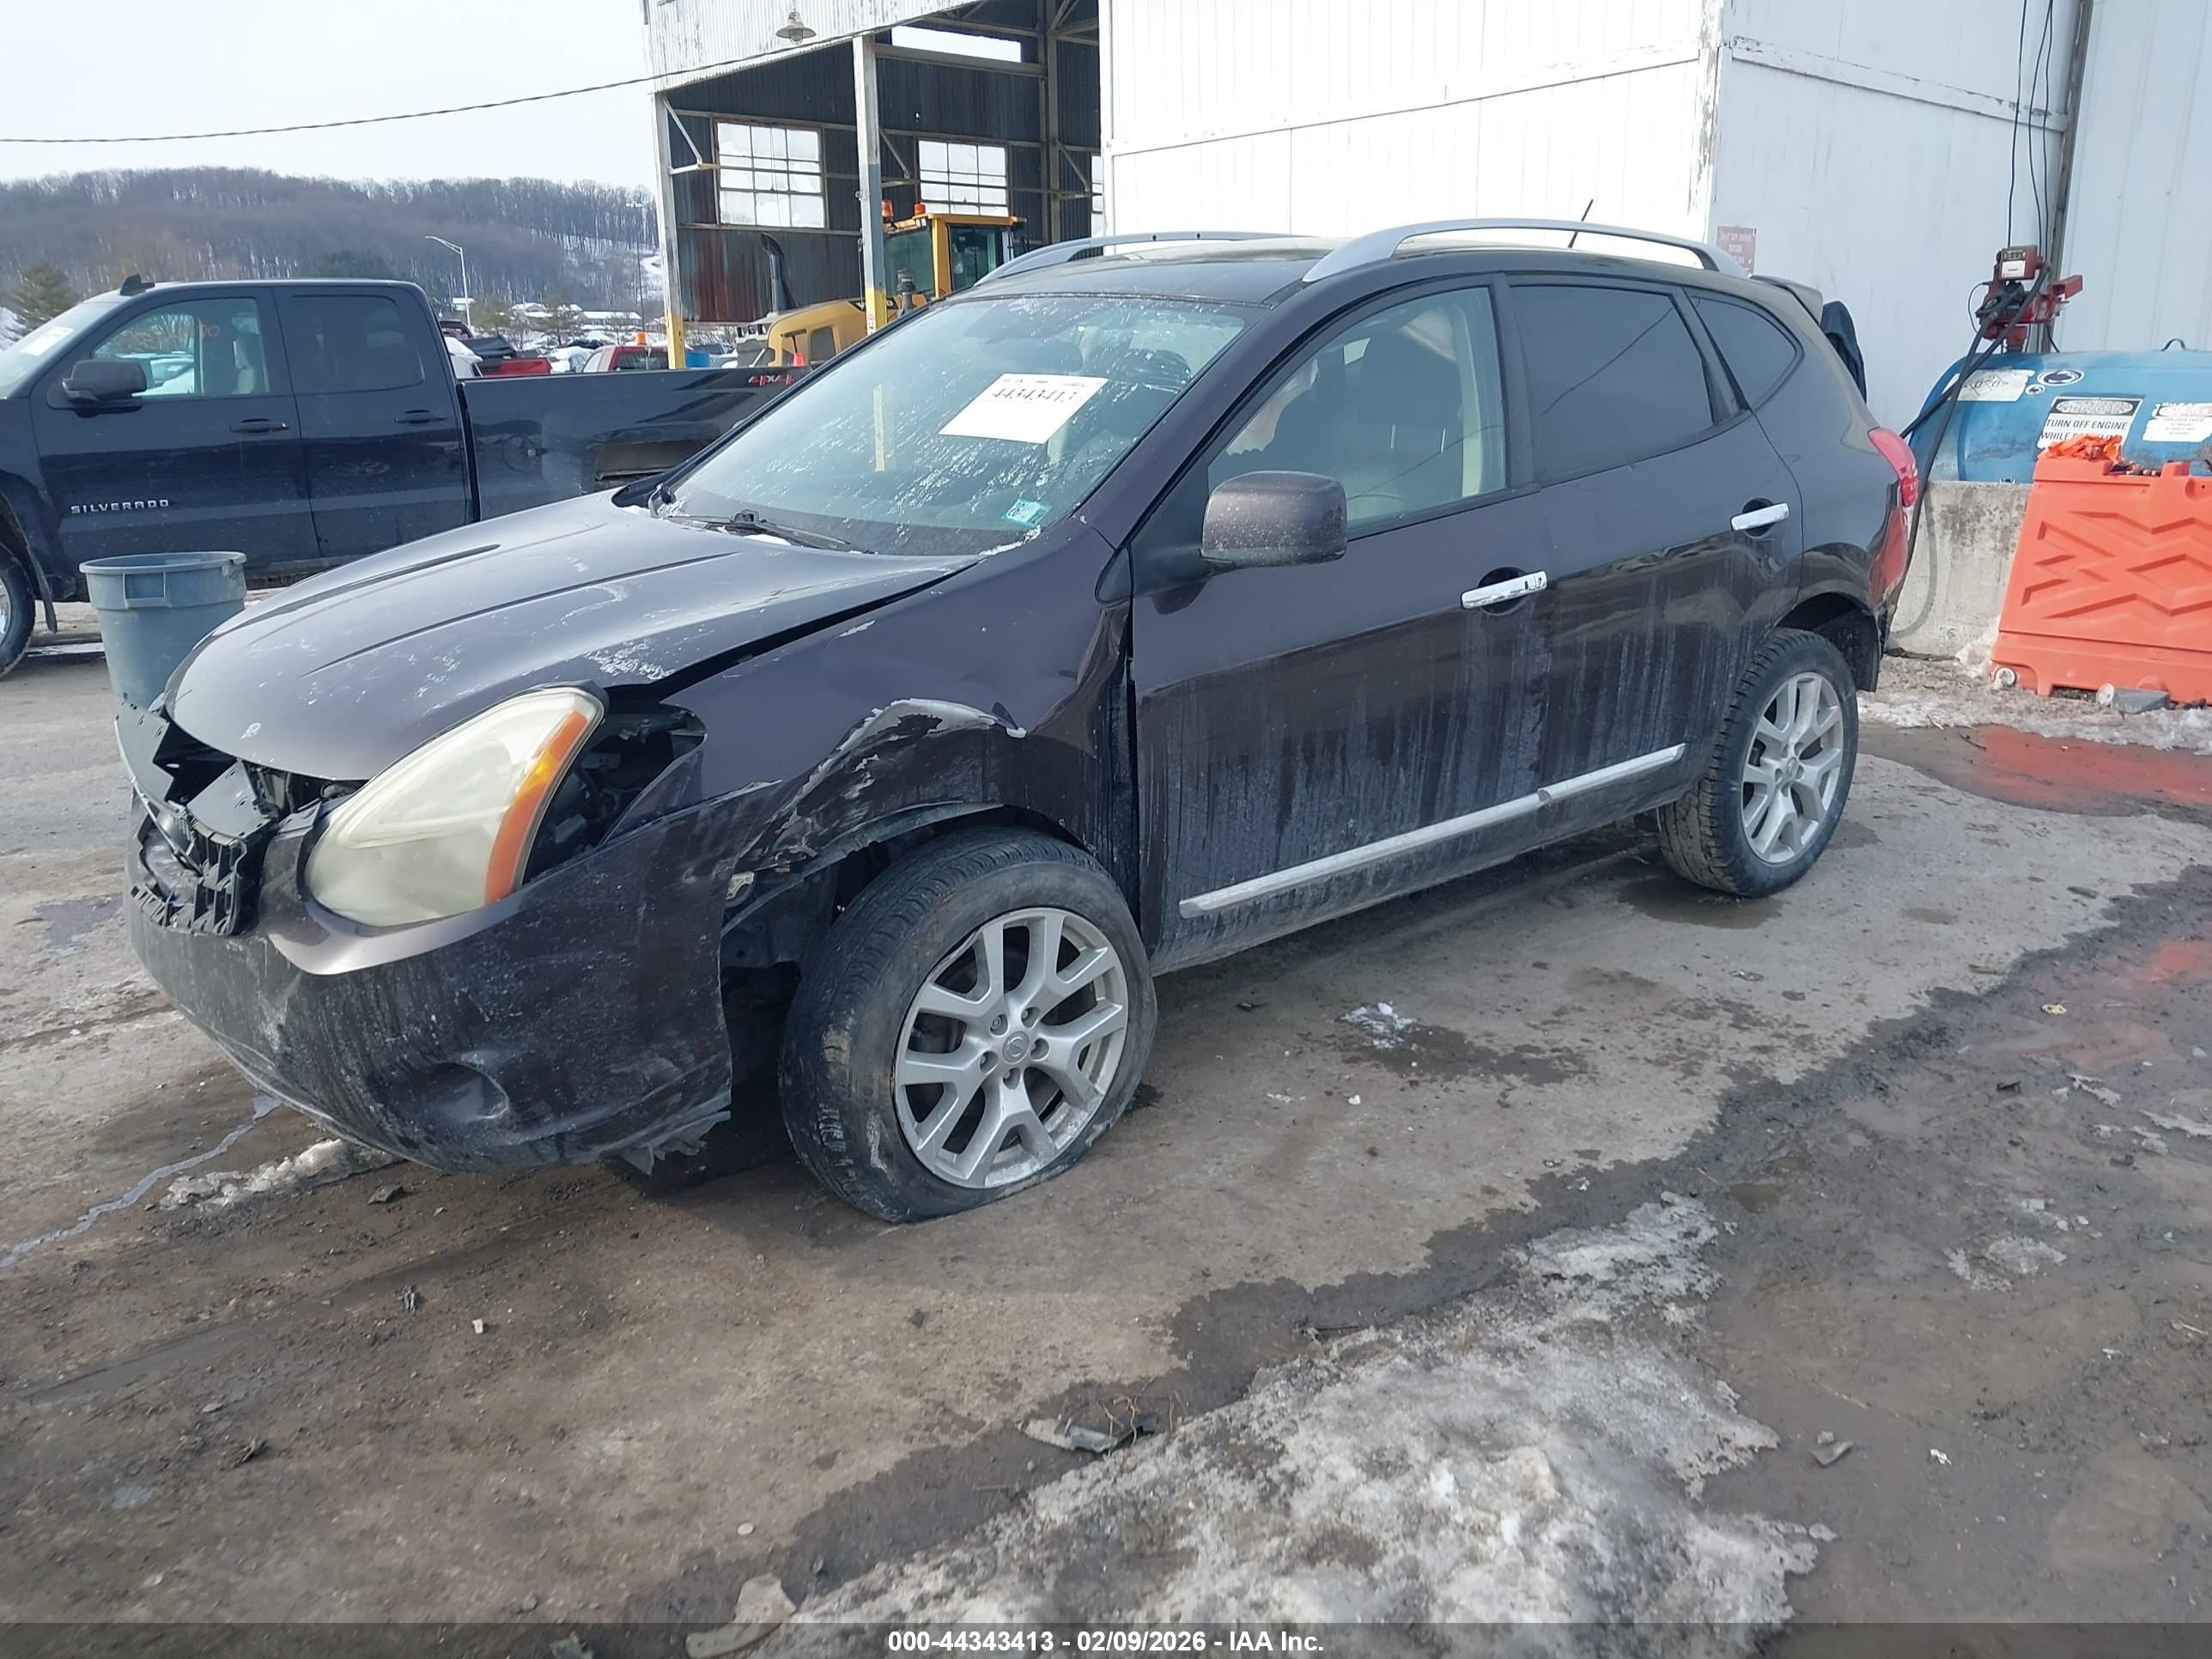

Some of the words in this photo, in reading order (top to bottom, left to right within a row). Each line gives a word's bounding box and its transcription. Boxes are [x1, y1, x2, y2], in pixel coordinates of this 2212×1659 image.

[2046, 418, 2071, 428] TURN
[2073, 420, 2091, 428] OFF
[2092, 421, 2129, 430] ENGINE
[2041, 431, 2070, 440] WHILE
[70, 499, 169, 514] SILVERADO
